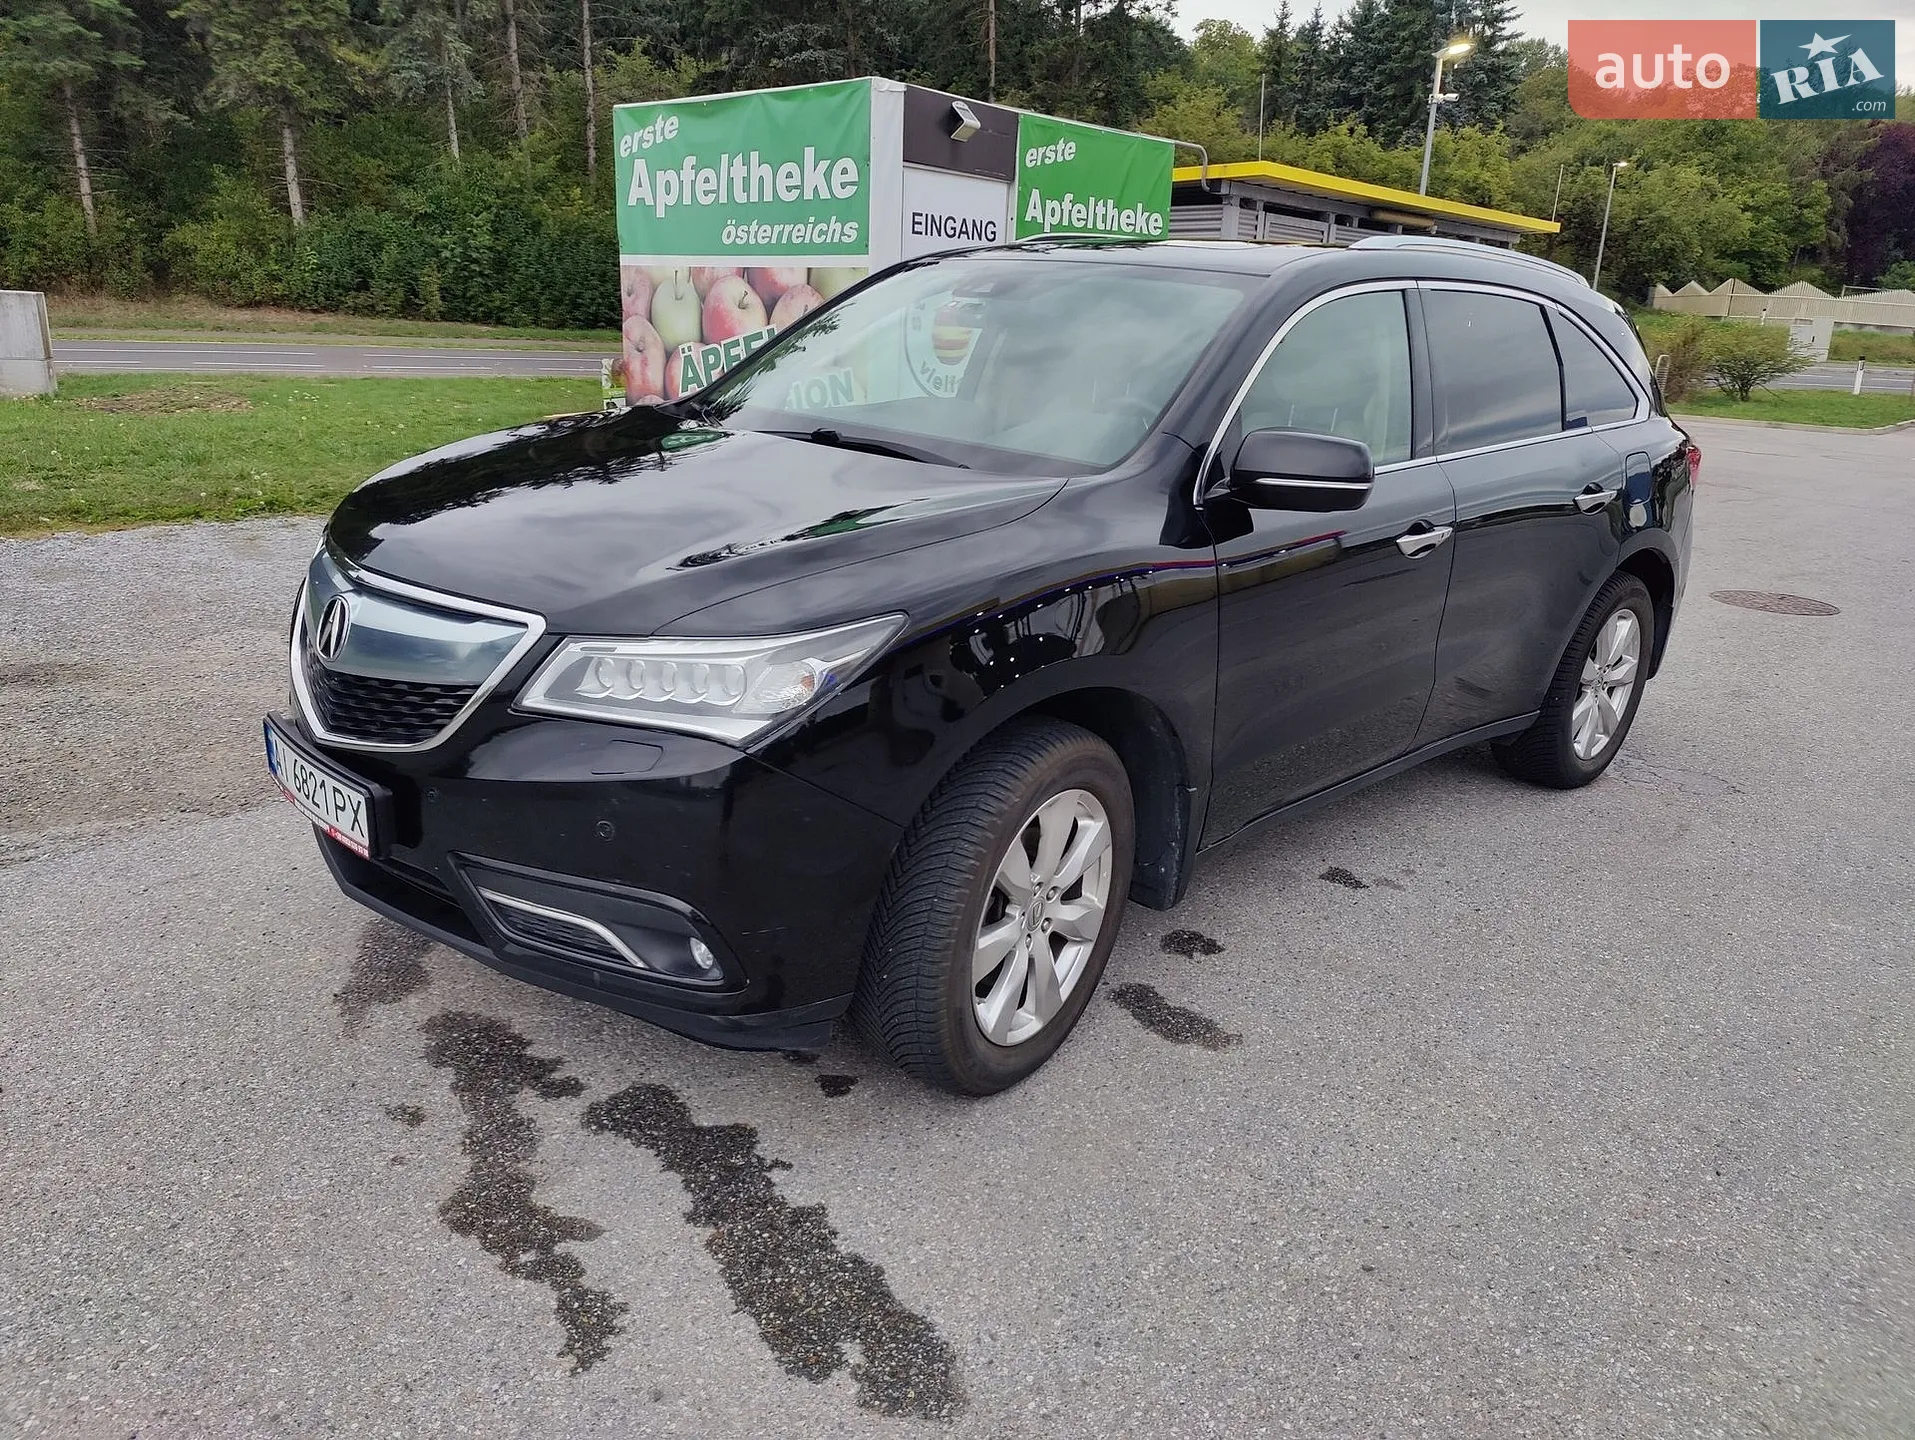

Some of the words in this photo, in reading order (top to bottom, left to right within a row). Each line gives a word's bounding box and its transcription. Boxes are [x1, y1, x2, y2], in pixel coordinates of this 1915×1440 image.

[619, 113, 680, 158] erste
[1025, 137, 1077, 167] erste
[627, 146, 860, 218] Apfeltheke
[721, 215, 859, 246] österreichs
[911, 211, 998, 243] EINGANG
[1024, 188, 1164, 237] Apfeltheke
[293, 758, 329, 816] 6821
[332, 785, 365, 838] PX
